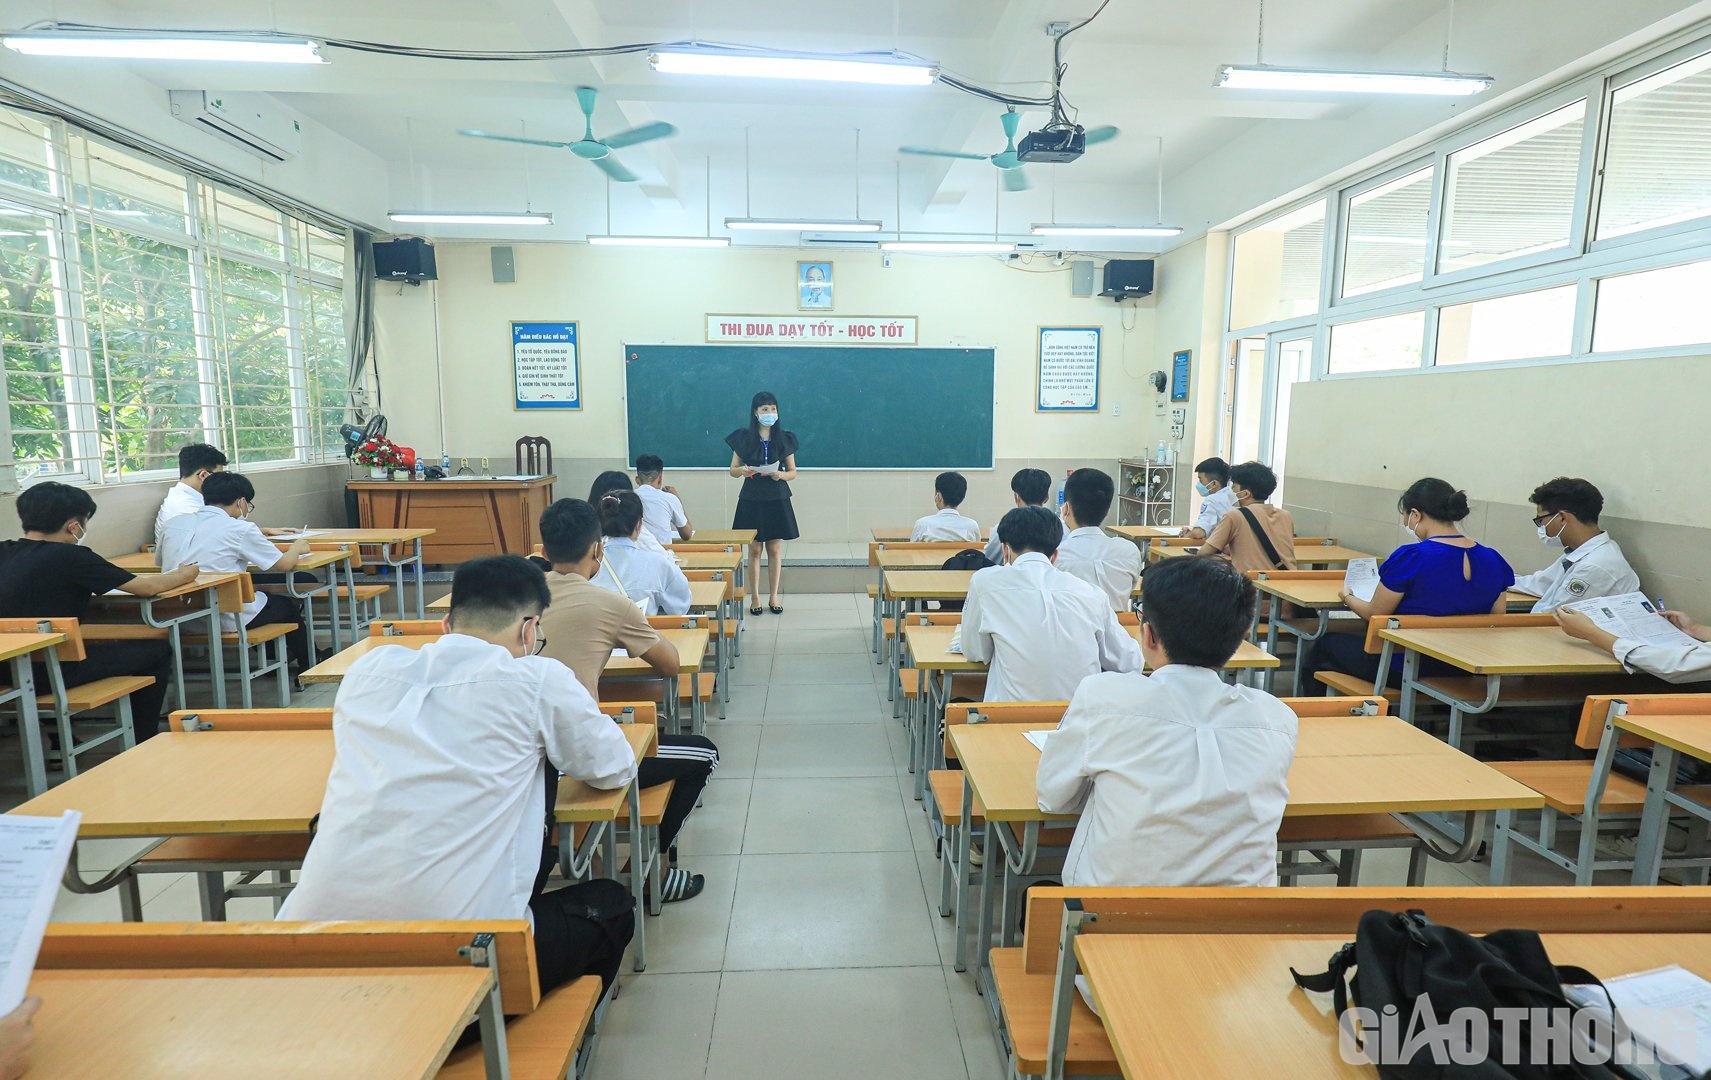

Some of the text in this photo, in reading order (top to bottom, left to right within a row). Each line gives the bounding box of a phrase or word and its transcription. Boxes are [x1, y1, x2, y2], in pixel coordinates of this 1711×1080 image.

[720, 323, 741, 336] THI
[746, 324, 774, 336] ĐUA
[779, 324, 805, 338] DẠY
[810, 320, 834, 336] TỐT
[848, 325, 876, 340] HỌC
[880, 321, 904, 338] TỐT
